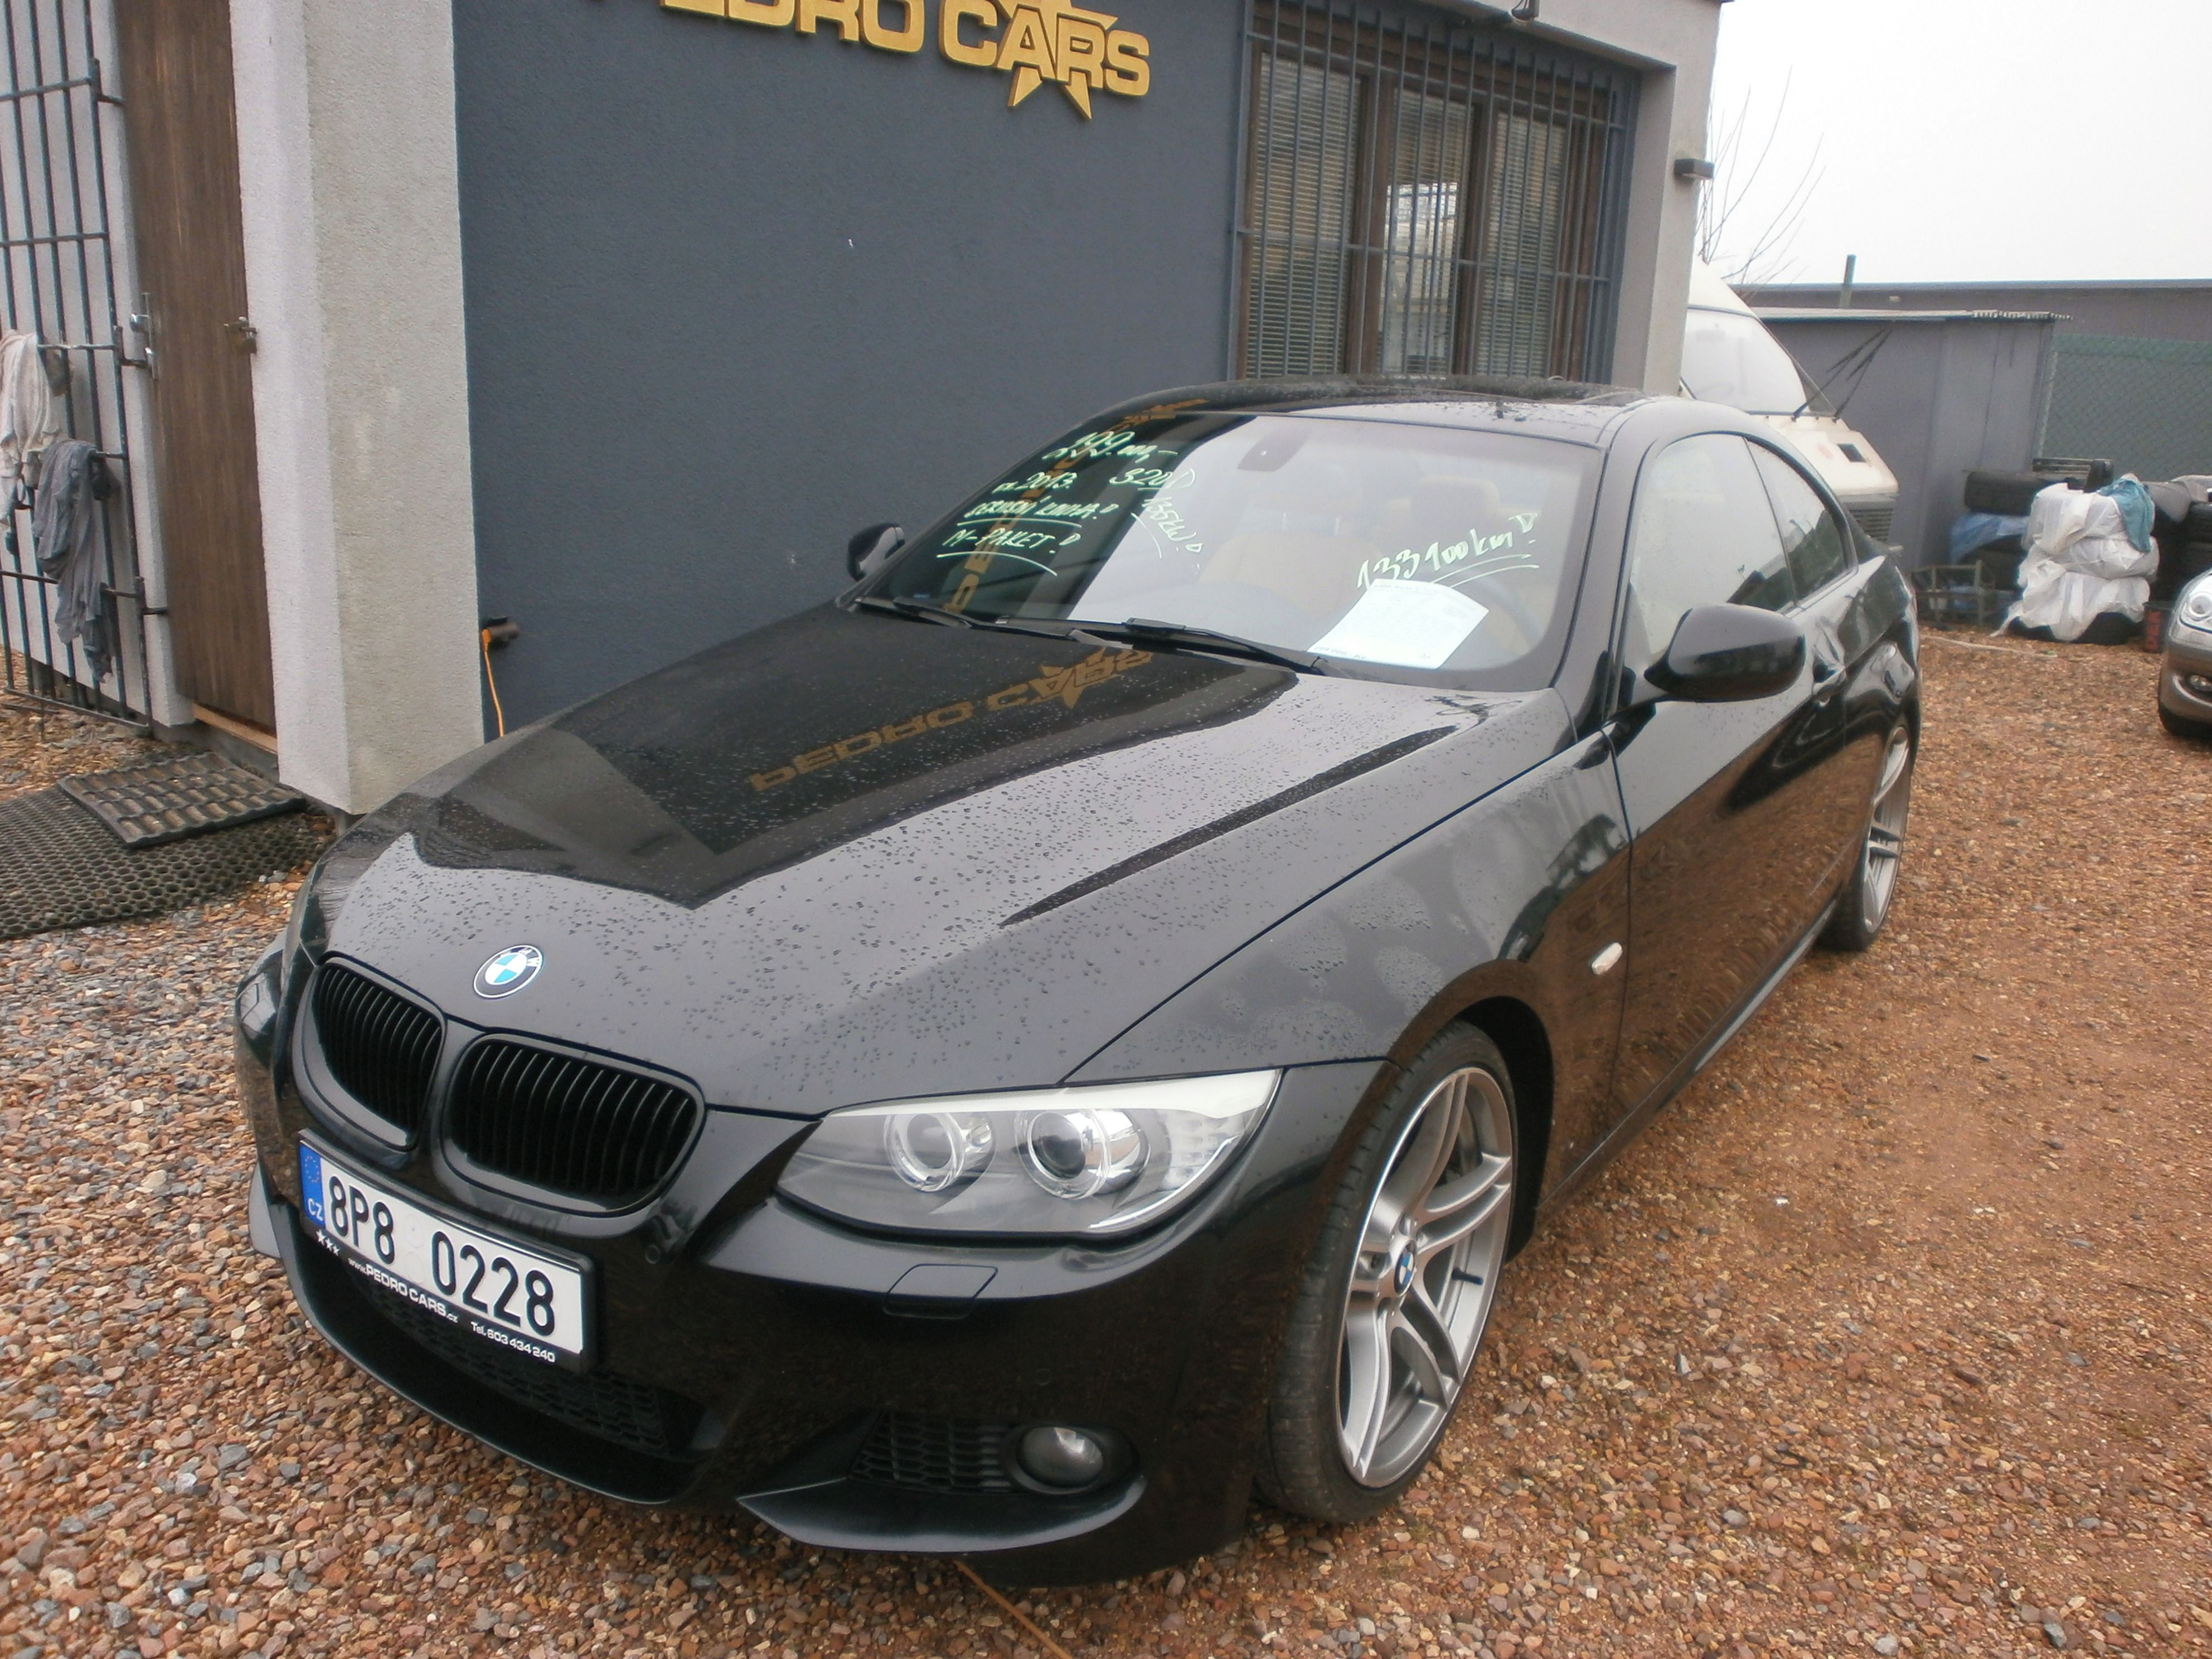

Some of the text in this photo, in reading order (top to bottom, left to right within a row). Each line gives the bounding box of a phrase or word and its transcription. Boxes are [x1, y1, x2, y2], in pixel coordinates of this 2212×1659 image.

[939, 0, 1150, 96] CARS
[308, 1197, 323, 1221] CZ
[328, 1175, 555, 1337] 8P8 0228
[487, 1328, 508, 1345] 603
[509, 1338, 532, 1354] 434
[532, 1346, 555, 1363] 240
